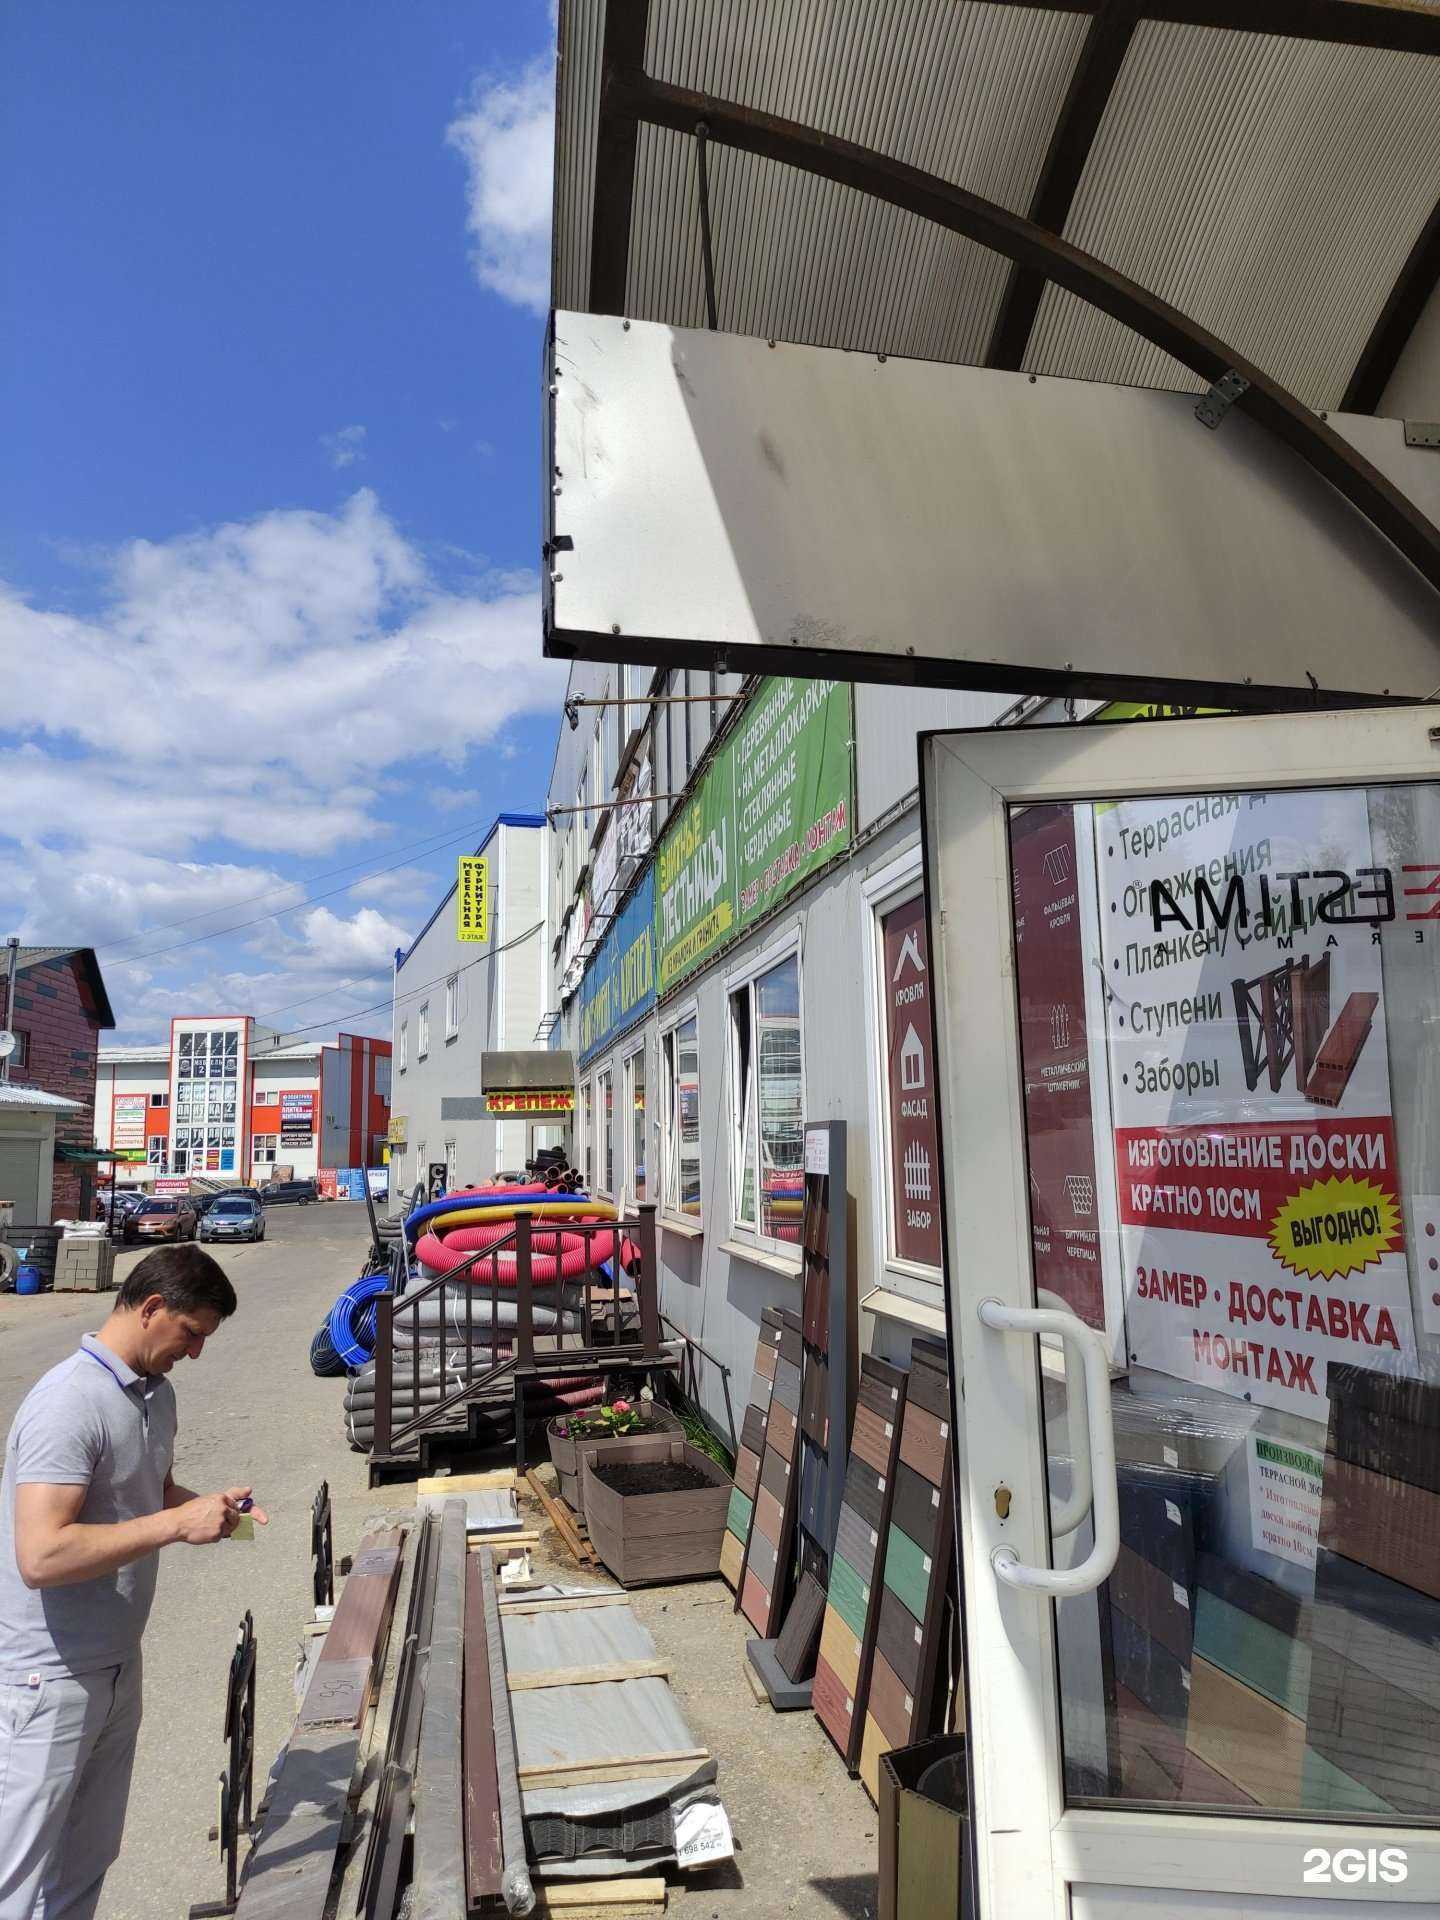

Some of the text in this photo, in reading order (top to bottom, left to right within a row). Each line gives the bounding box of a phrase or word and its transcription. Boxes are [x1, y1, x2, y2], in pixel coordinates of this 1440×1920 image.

[741, 677, 794, 766] ДЕРЕВЯННЫЕ
[743, 768, 753, 799] НА
[744, 751, 797, 833] СТЕКЛЯННЫЕ
[745, 798, 792, 866] ЧЕРДАЧНЫЕ
[463, 862, 472, 928] МЕБЕЛЬНАЯ
[474, 863, 484, 928] ФУРНИТУРА
[662, 815, 727, 949] ЛЕСТНИЦЫ
[895, 982, 924, 1007] КРОВЛЯ
[1131, 992, 1222, 1037] Ступени
[1135, 1057, 1220, 1096] Заборы
[489, 1093, 573, 1110] КРЕПЕЖ
[901, 1099, 928, 1121] ФАСАД
[1128, 1134, 1387, 1175] ИЗГОТОВЛЕНИЕ ДОСКИ
[906, 1209, 931, 1230] ЗАБОР
[1131, 1184, 1262, 1220] КРАТНО 10СМ
[1291, 1205, 1382, 1248] ВЫГОДНО!
[1067, 1246, 1097, 1263] ЧЕРЕПИЦА
[1136, 1266, 1401, 1350] ЗАМЕР ДОСТАВКА
[1192, 1328, 1318, 1396] МОНТАЖ
